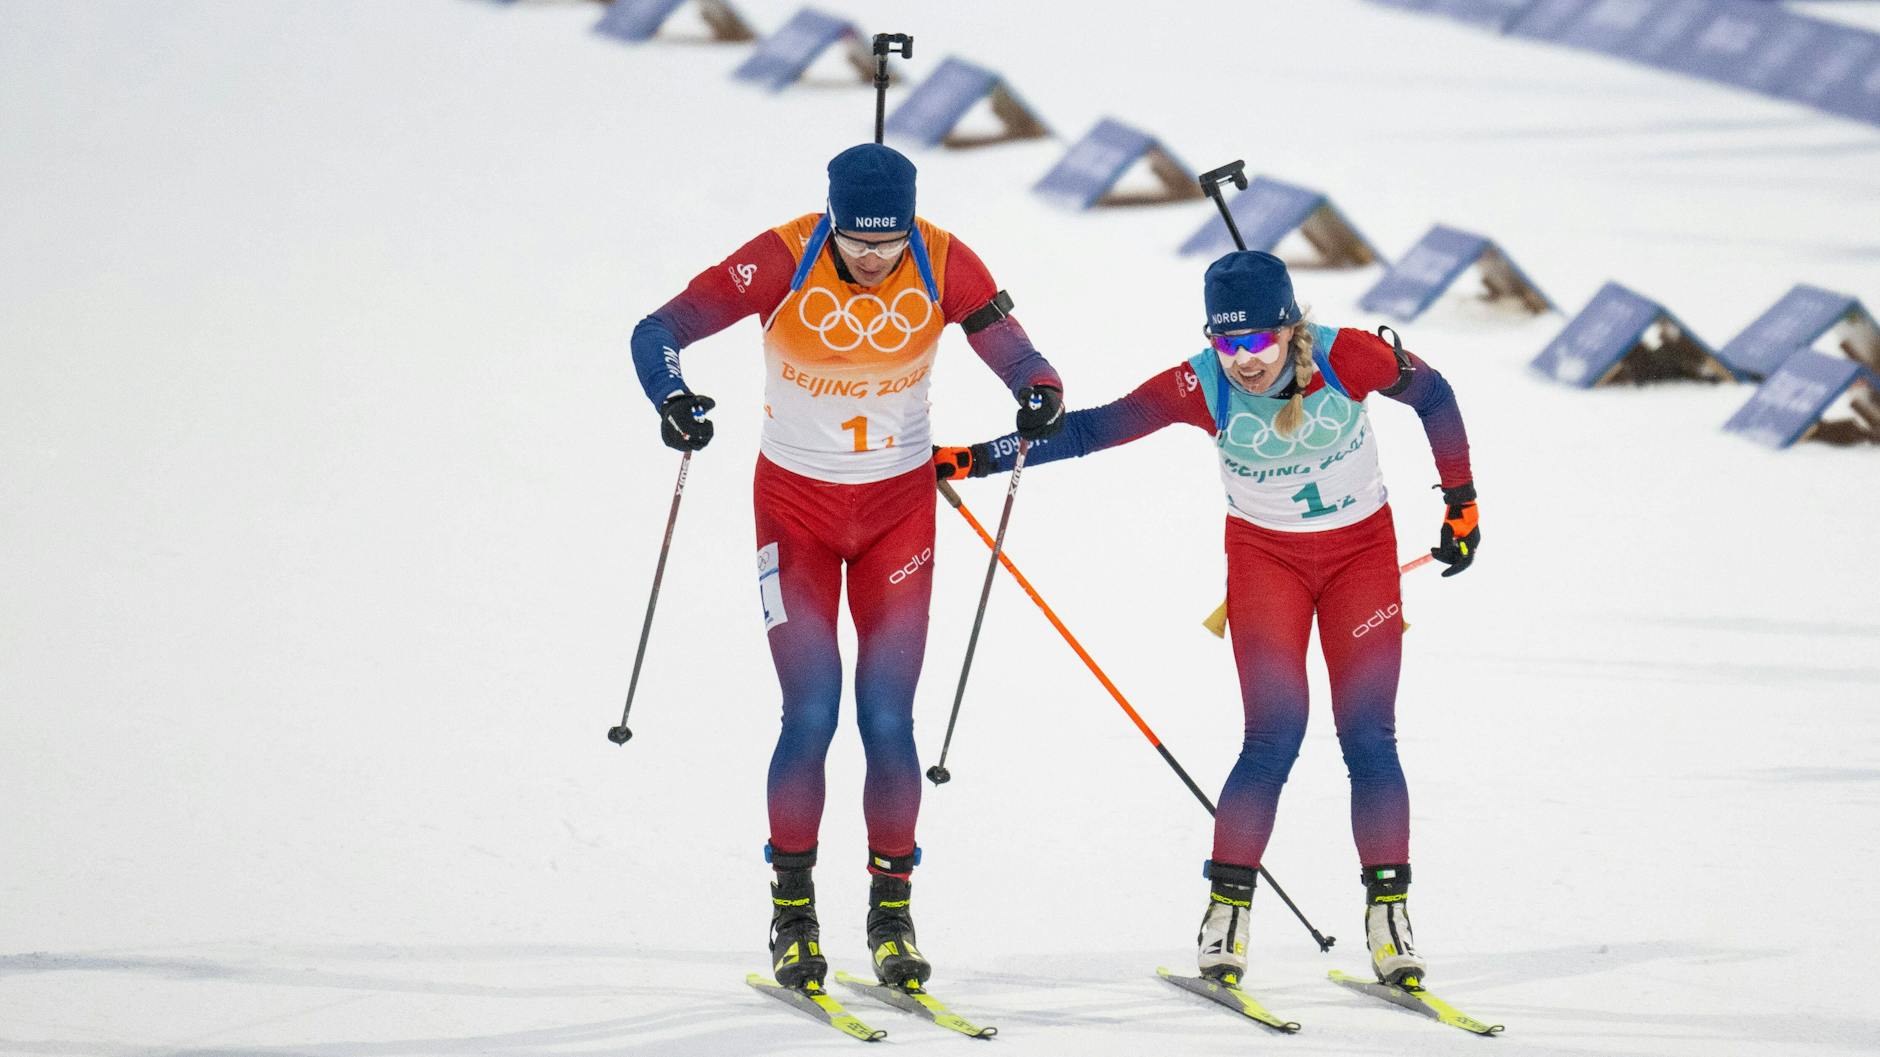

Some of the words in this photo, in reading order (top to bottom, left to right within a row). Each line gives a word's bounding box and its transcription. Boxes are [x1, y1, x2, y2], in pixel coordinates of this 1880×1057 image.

[855, 216, 897, 228] NORGE
[1211, 310, 1247, 325] NORGE
[782, 361, 870, 399] BEIJING
[876, 364, 929, 397] 2022
[841, 415, 874, 453] 1
[991, 436, 1049, 459] RGE
[1291, 482, 1338, 519] 1
[889, 547, 931, 584] odlo
[1352, 603, 1399, 638] odlo
